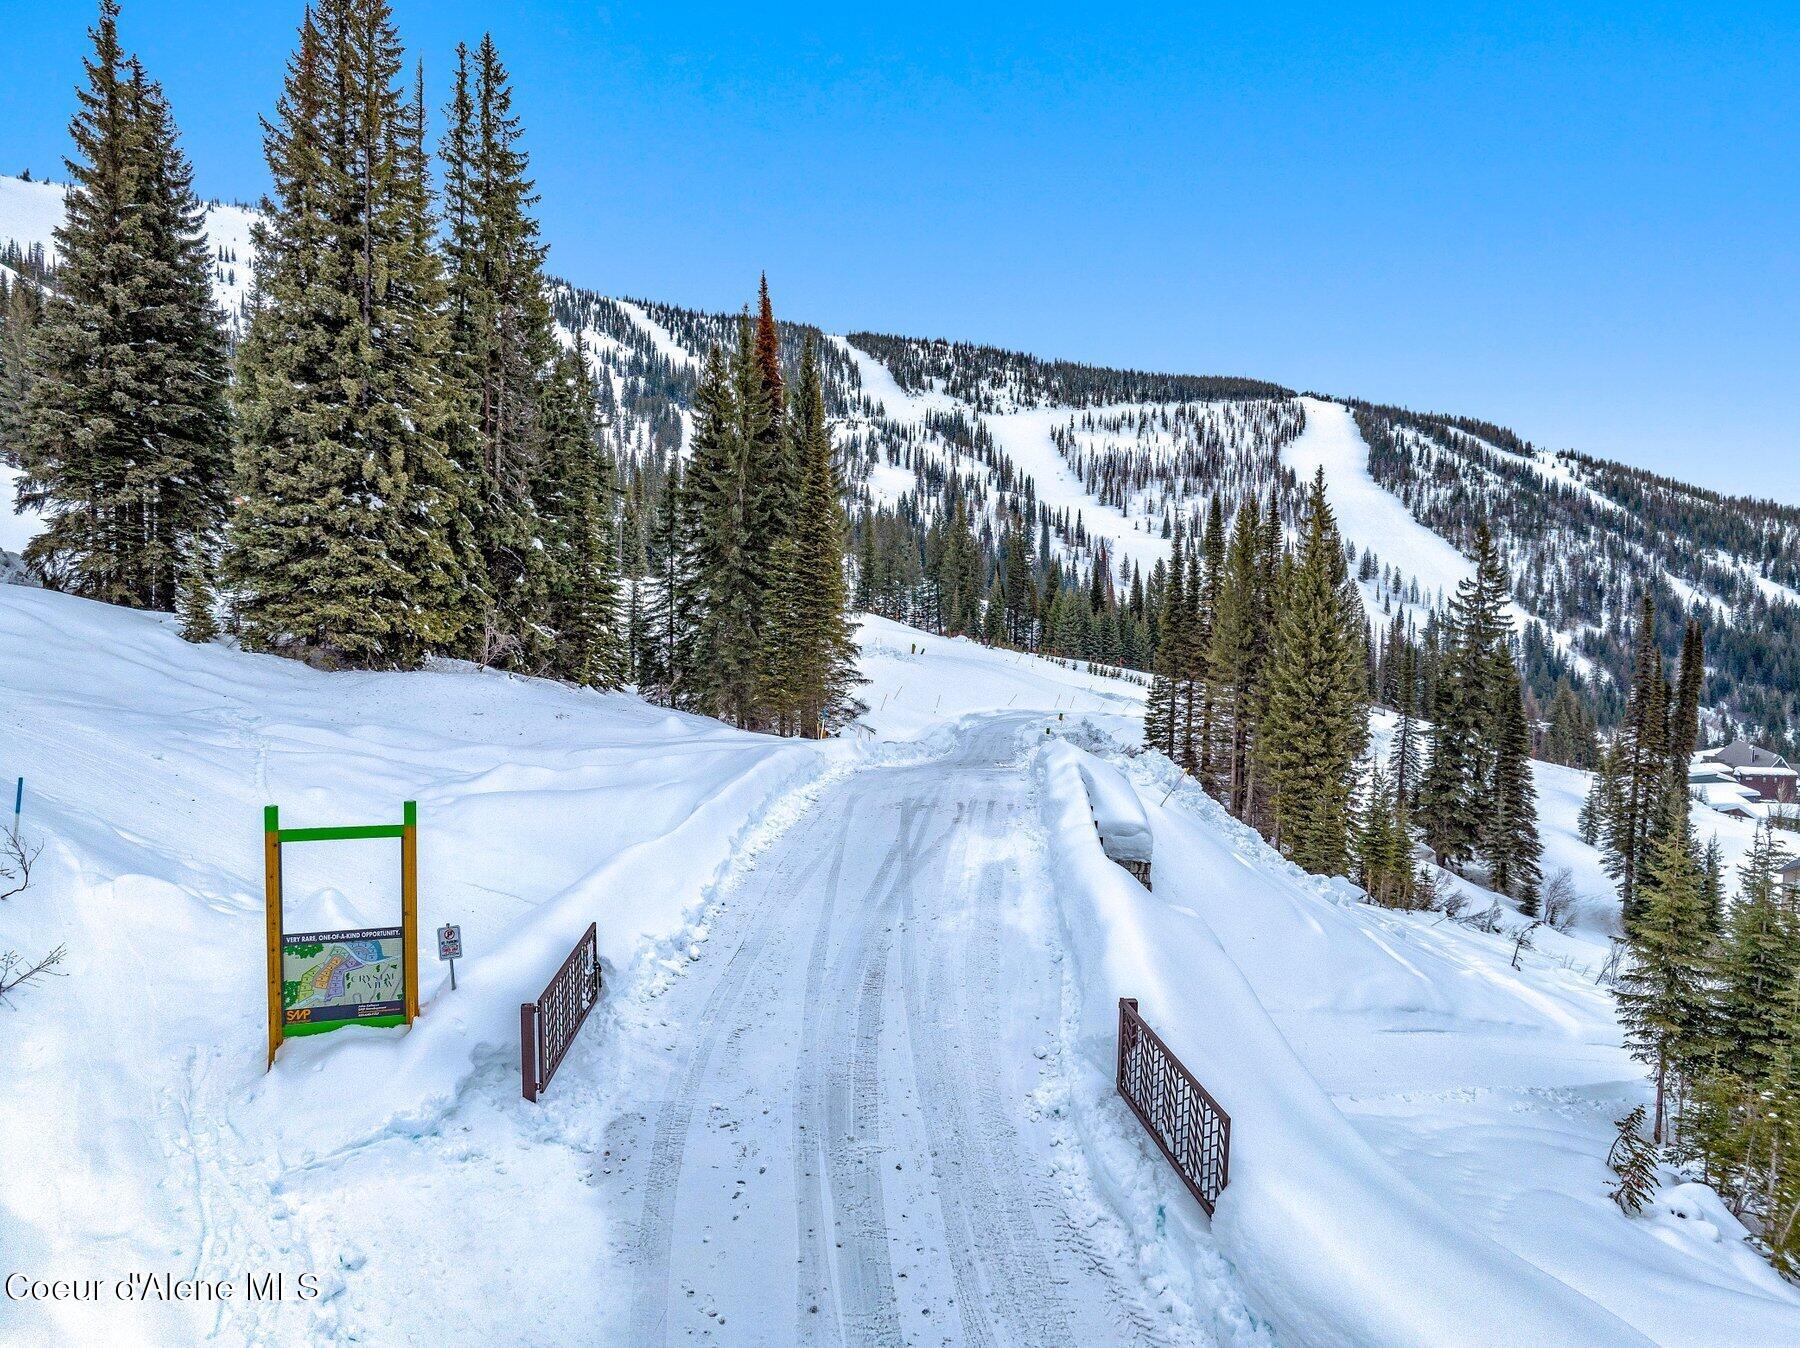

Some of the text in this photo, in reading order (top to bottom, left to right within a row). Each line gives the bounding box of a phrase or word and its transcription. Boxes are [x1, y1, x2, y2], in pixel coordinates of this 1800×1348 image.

[301, 935, 318, 943] RARE,
[318, 932, 361, 941] ONE-OF-A-KIND
[361, 929, 401, 939] OPPORTUNITY.
[286, 1009, 311, 1021] SMP
